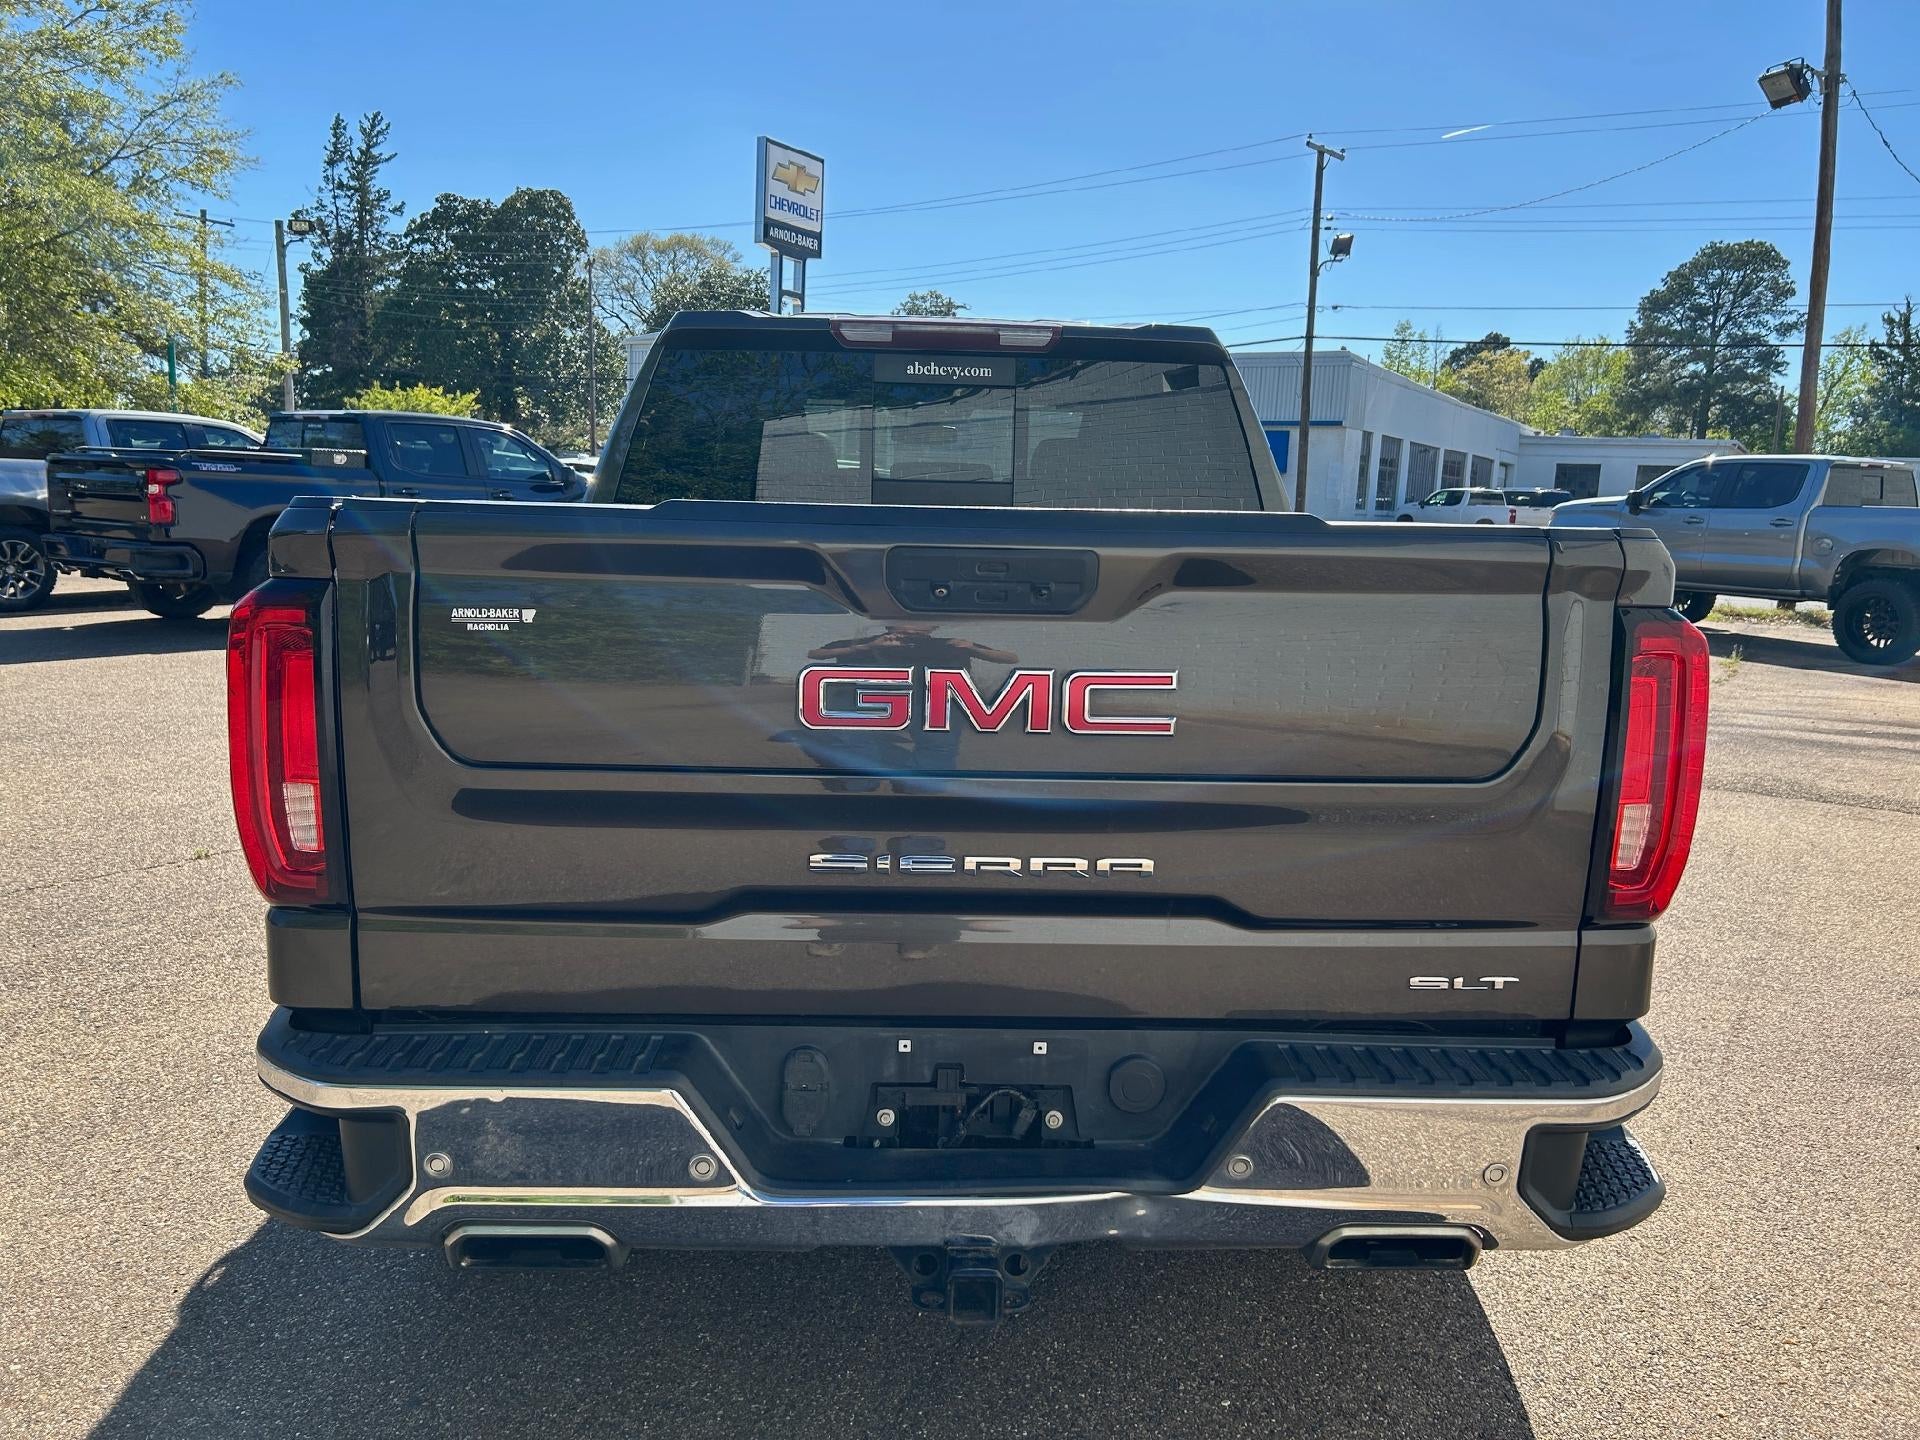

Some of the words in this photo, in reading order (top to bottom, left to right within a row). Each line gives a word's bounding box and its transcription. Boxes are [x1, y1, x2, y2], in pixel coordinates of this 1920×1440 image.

[769, 193, 821, 222] CHEVROLET
[769, 226, 819, 251] ARNOLD-BAKER
[906, 361, 992, 380] abchevy.com
[451, 607, 520, 618] ARNOLD-BAKER
[466, 623, 510, 631] MAGNOLIA
[798, 665, 1179, 736] GMC
[808, 853, 1155, 878] SIERRA
[1409, 976, 1520, 990] SLT
